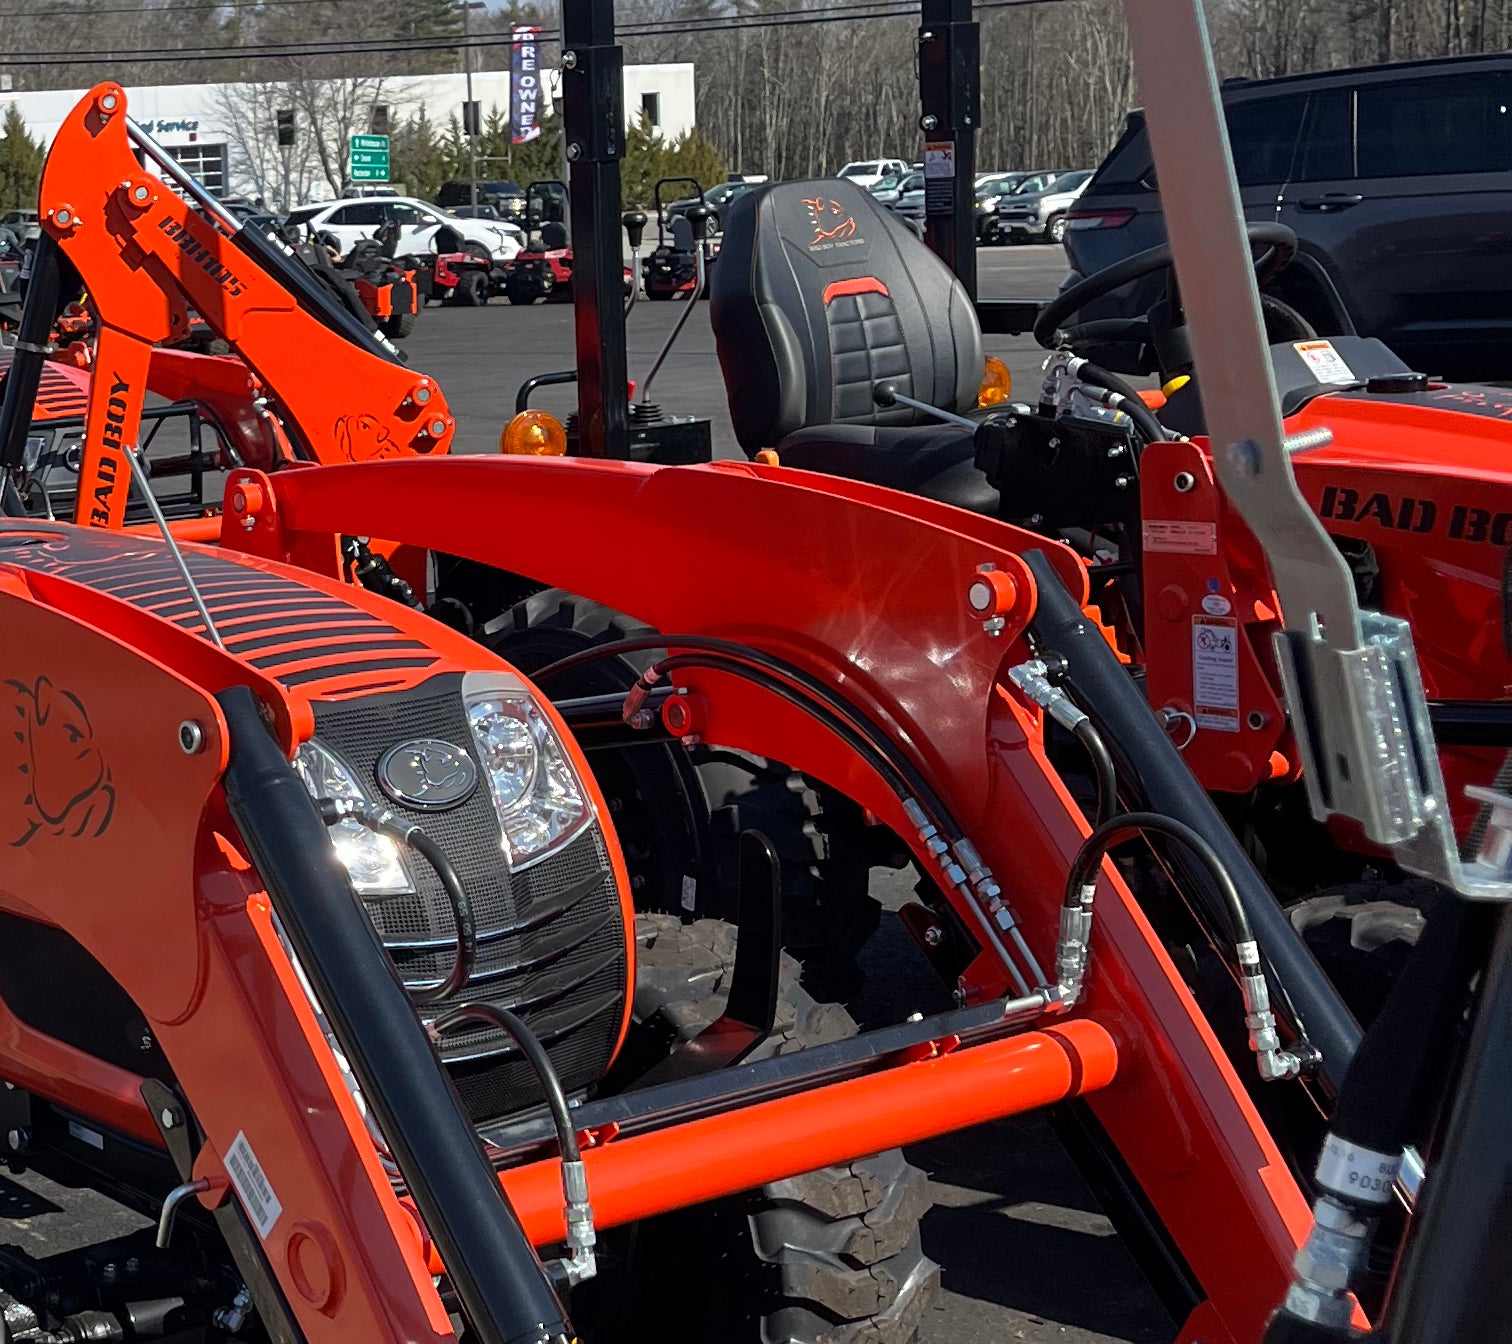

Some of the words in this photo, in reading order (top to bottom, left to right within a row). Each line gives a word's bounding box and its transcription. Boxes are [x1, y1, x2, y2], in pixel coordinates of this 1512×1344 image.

[157, 119, 199, 133] Service
[102, 371, 130, 450] BOY
[89, 457, 118, 529] BAD
[1320, 486, 1437, 533] BAD
[1448, 506, 1512, 546] BO
